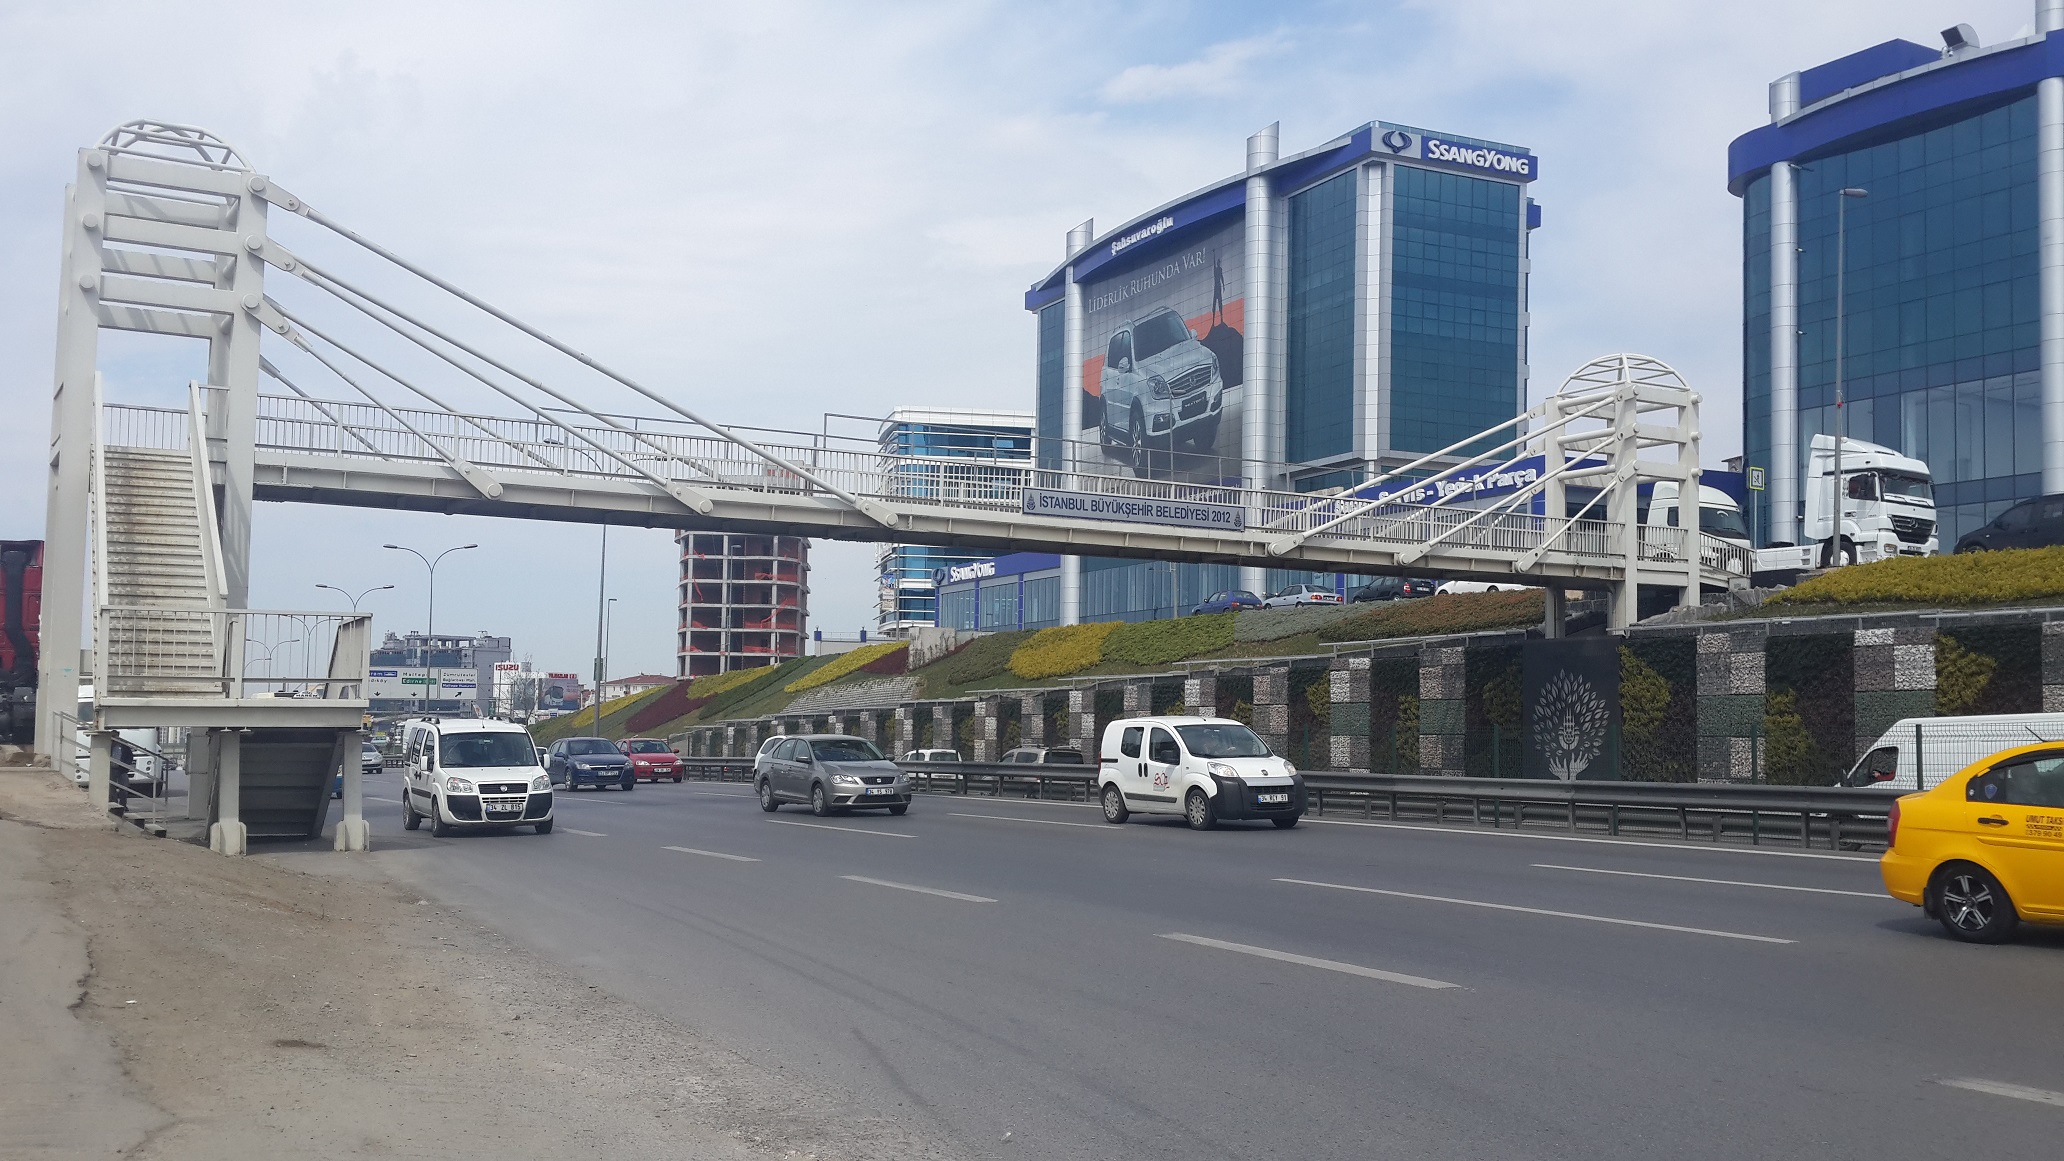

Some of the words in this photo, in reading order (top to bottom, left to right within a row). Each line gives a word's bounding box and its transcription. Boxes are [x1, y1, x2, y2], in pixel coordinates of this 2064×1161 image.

[1111, 216, 1174, 256] Şahsuvaroğlu
[1088, 284, 1129, 314] LİDERLİK
[1130, 261, 1181, 296] RUHUNDA
[1182, 247, 1206, 270] VAR!
[1378, 487, 1425, 507] Svis
[1486, 468, 1537, 489] Parça
[1039, 492, 1089, 512] İSTANBUL
[1090, 498, 1154, 518] BÜYÜKŞEHİR
[1156, 504, 1210, 522] BELEDİYESİ
[1212, 509, 1231, 523] 2012
[2046, 816, 2064, 825] TAKS
